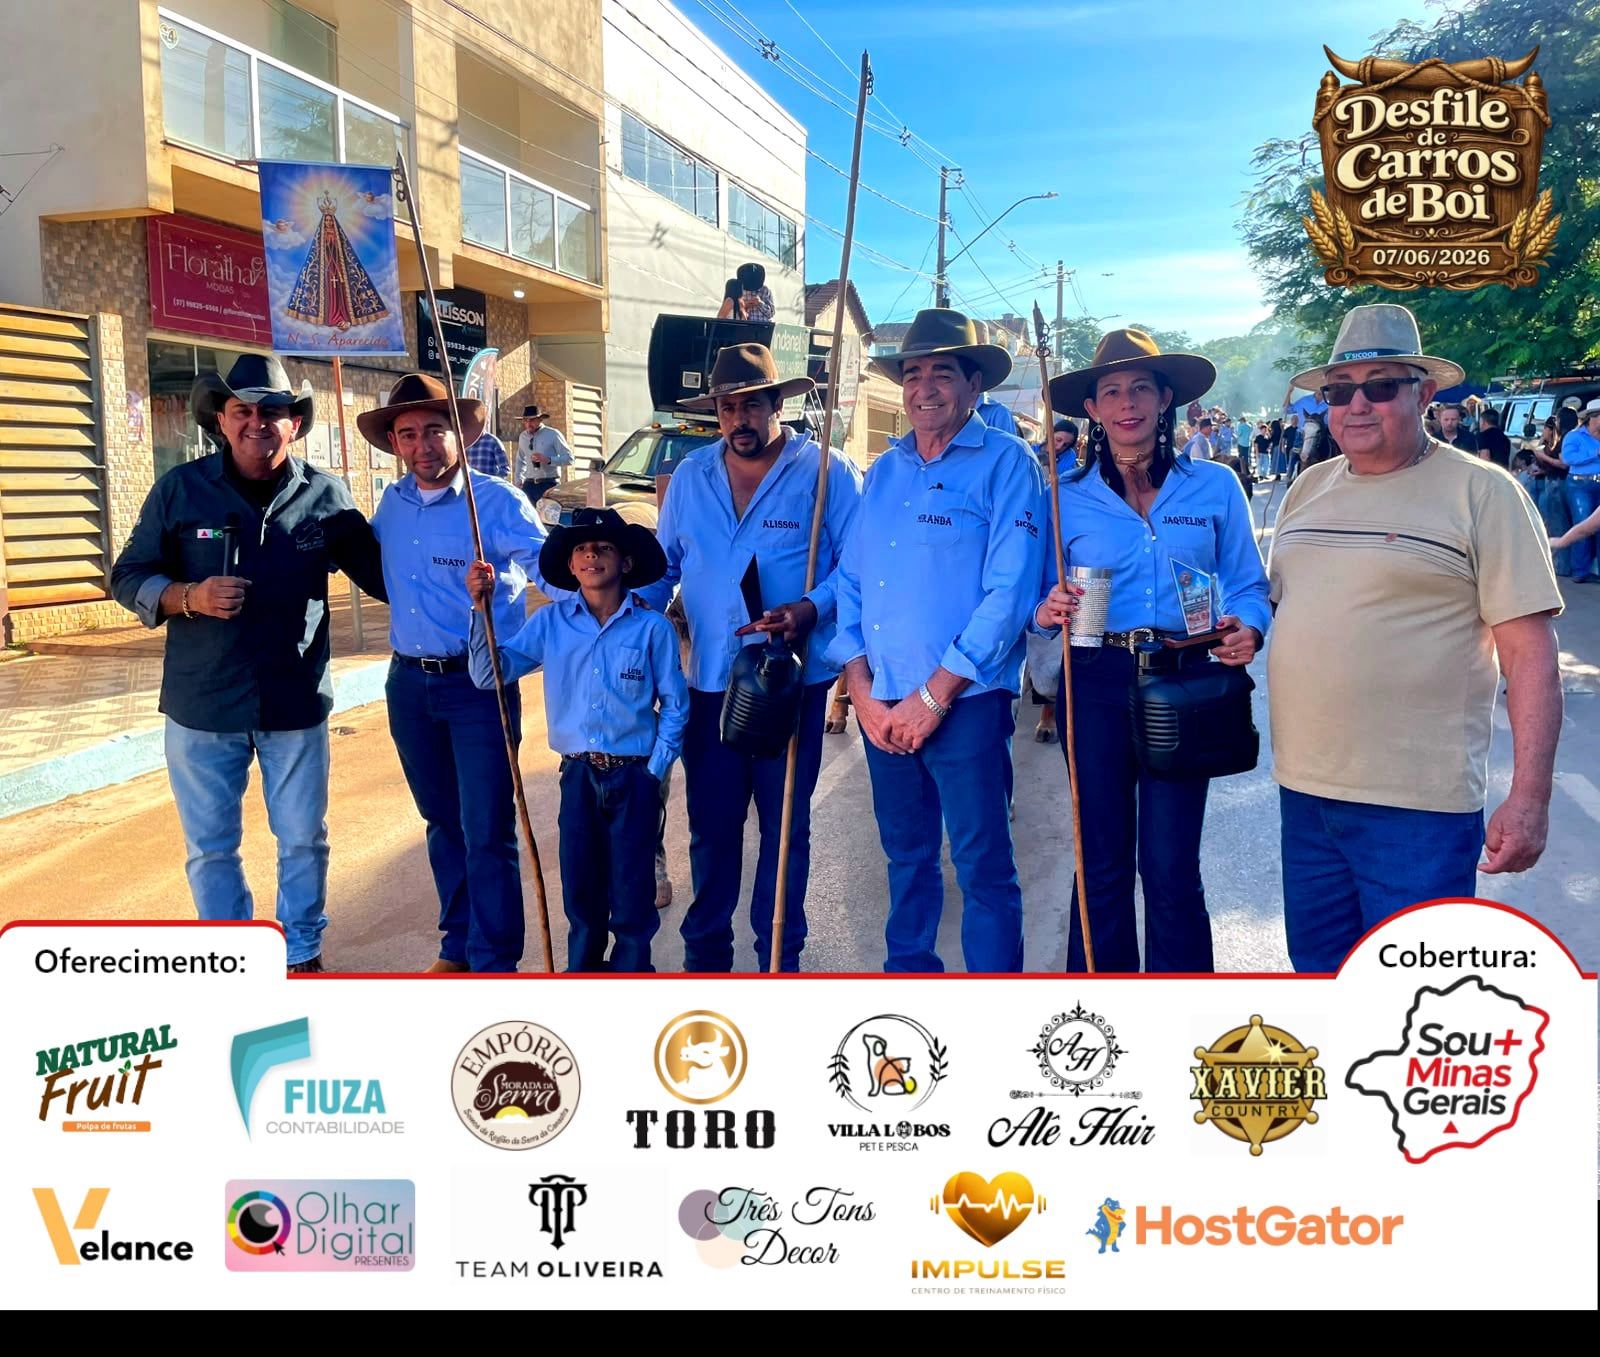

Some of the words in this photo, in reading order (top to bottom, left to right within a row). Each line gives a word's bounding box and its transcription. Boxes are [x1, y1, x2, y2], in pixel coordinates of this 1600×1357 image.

[206, 282, 234, 294] MODAS
[327, 332, 388, 349] Aparecida
[762, 520, 800, 530] ALISSON
[1162, 516, 1207, 527] JAQUELINE
[432, 557, 466, 568] RENATO
